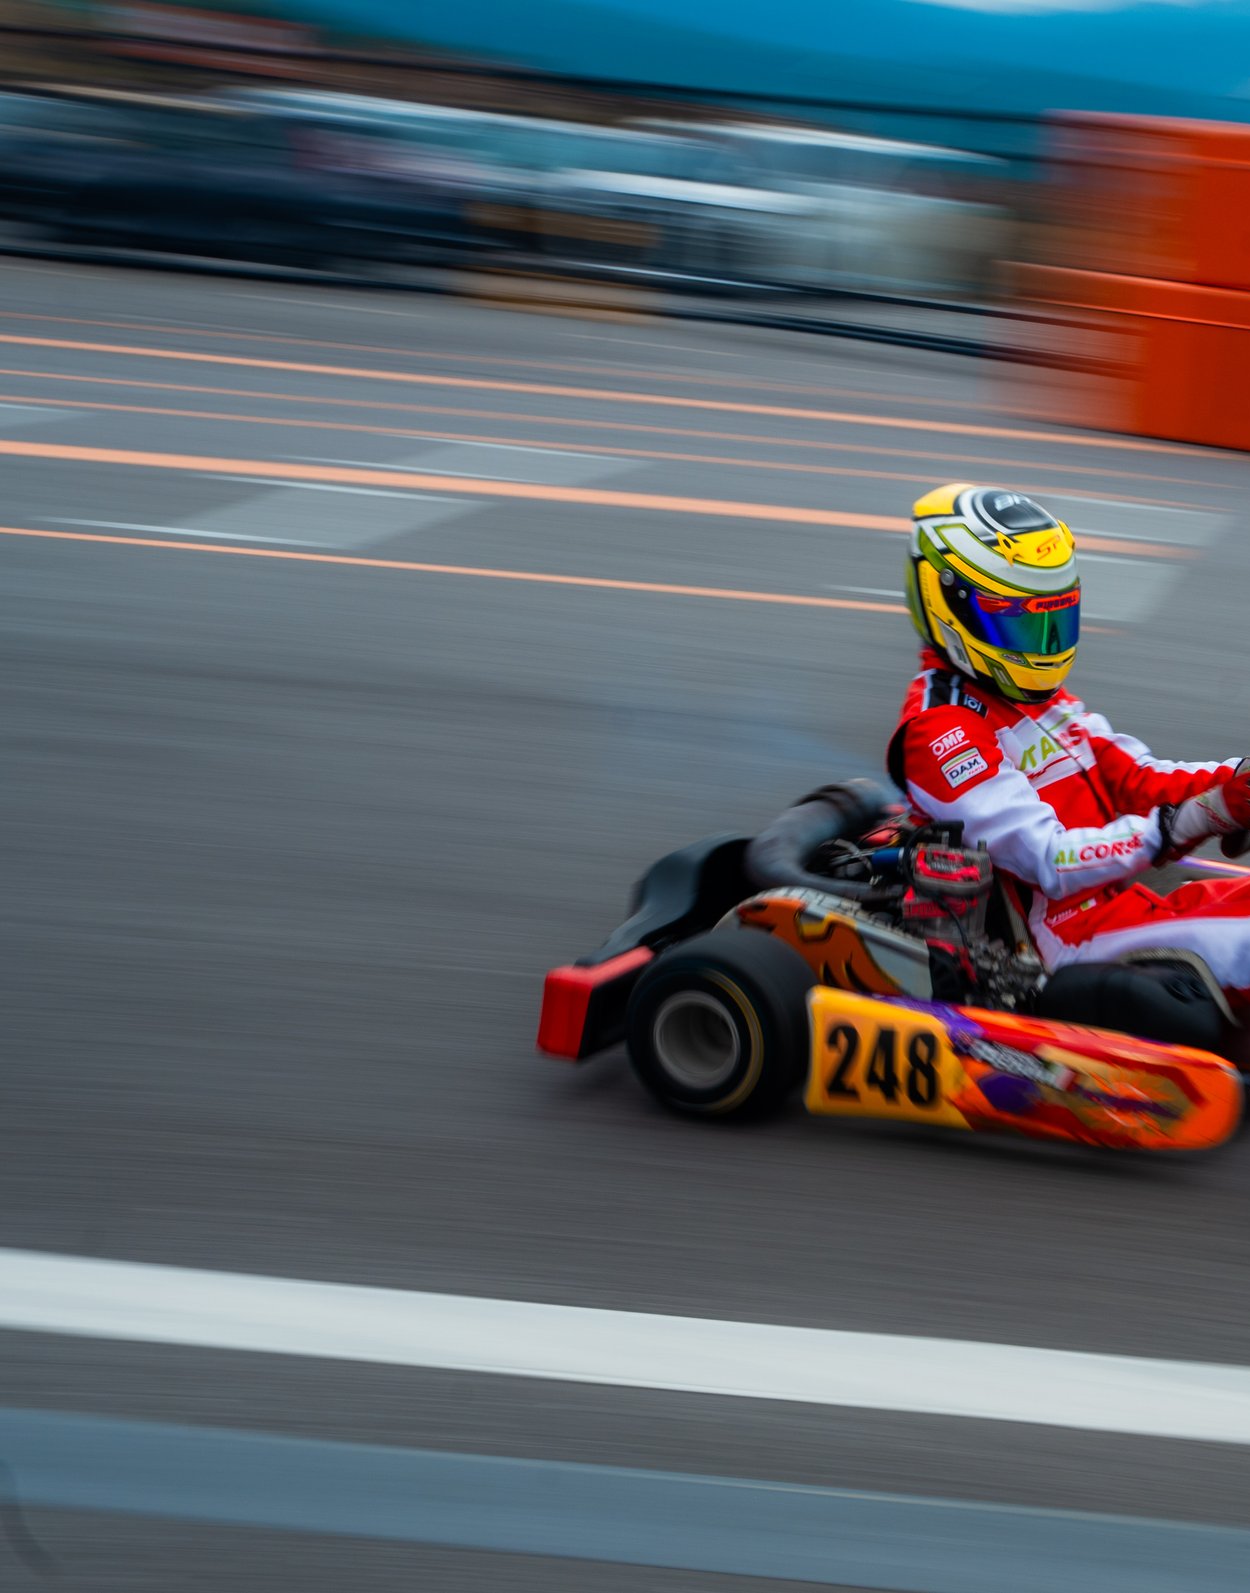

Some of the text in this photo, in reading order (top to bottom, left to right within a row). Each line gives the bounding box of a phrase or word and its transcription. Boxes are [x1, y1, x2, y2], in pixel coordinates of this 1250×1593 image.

[931, 728, 966, 757] OMP
[949, 758, 981, 780] DAM
[825, 1022, 941, 1107] 248
